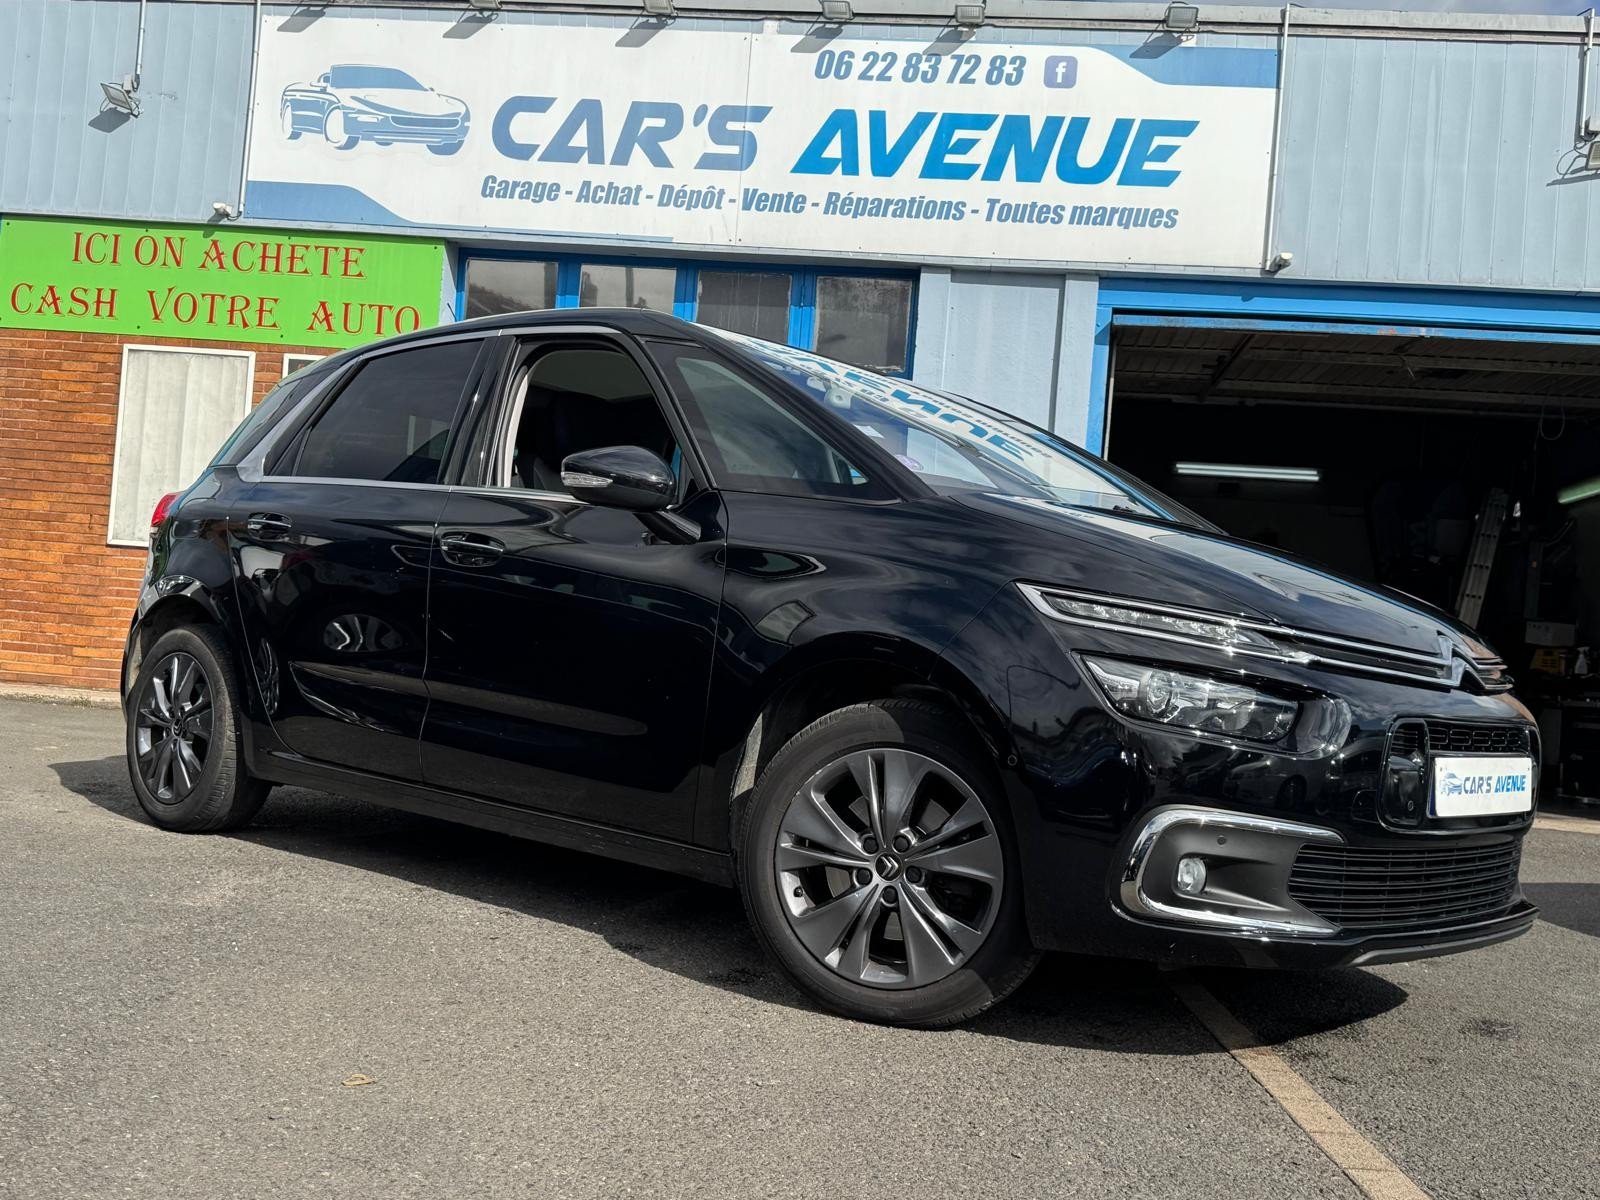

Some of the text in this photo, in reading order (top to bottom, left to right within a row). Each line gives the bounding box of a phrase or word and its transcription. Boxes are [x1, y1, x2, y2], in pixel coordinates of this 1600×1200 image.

[815, 49, 1027, 87] 06 22 83 72 83
[492, 95, 1201, 189] CAR'S AVENUE
[481, 175, 561, 204] Garage
[576, 180, 644, 207] Achat
[657, 184, 726, 211] Dépôt
[741, 188, 807, 213] Vente
[823, 191, 967, 222] Réparations
[985, 198, 1064, 225] Toutes
[1068, 204, 1179, 230] marques
[72, 231, 367, 279] ICI ON ACHETE
[10, 282, 422, 337] CASH VOTRE AUTO
[1464, 775, 1526, 794] CAR'S AVENUE
